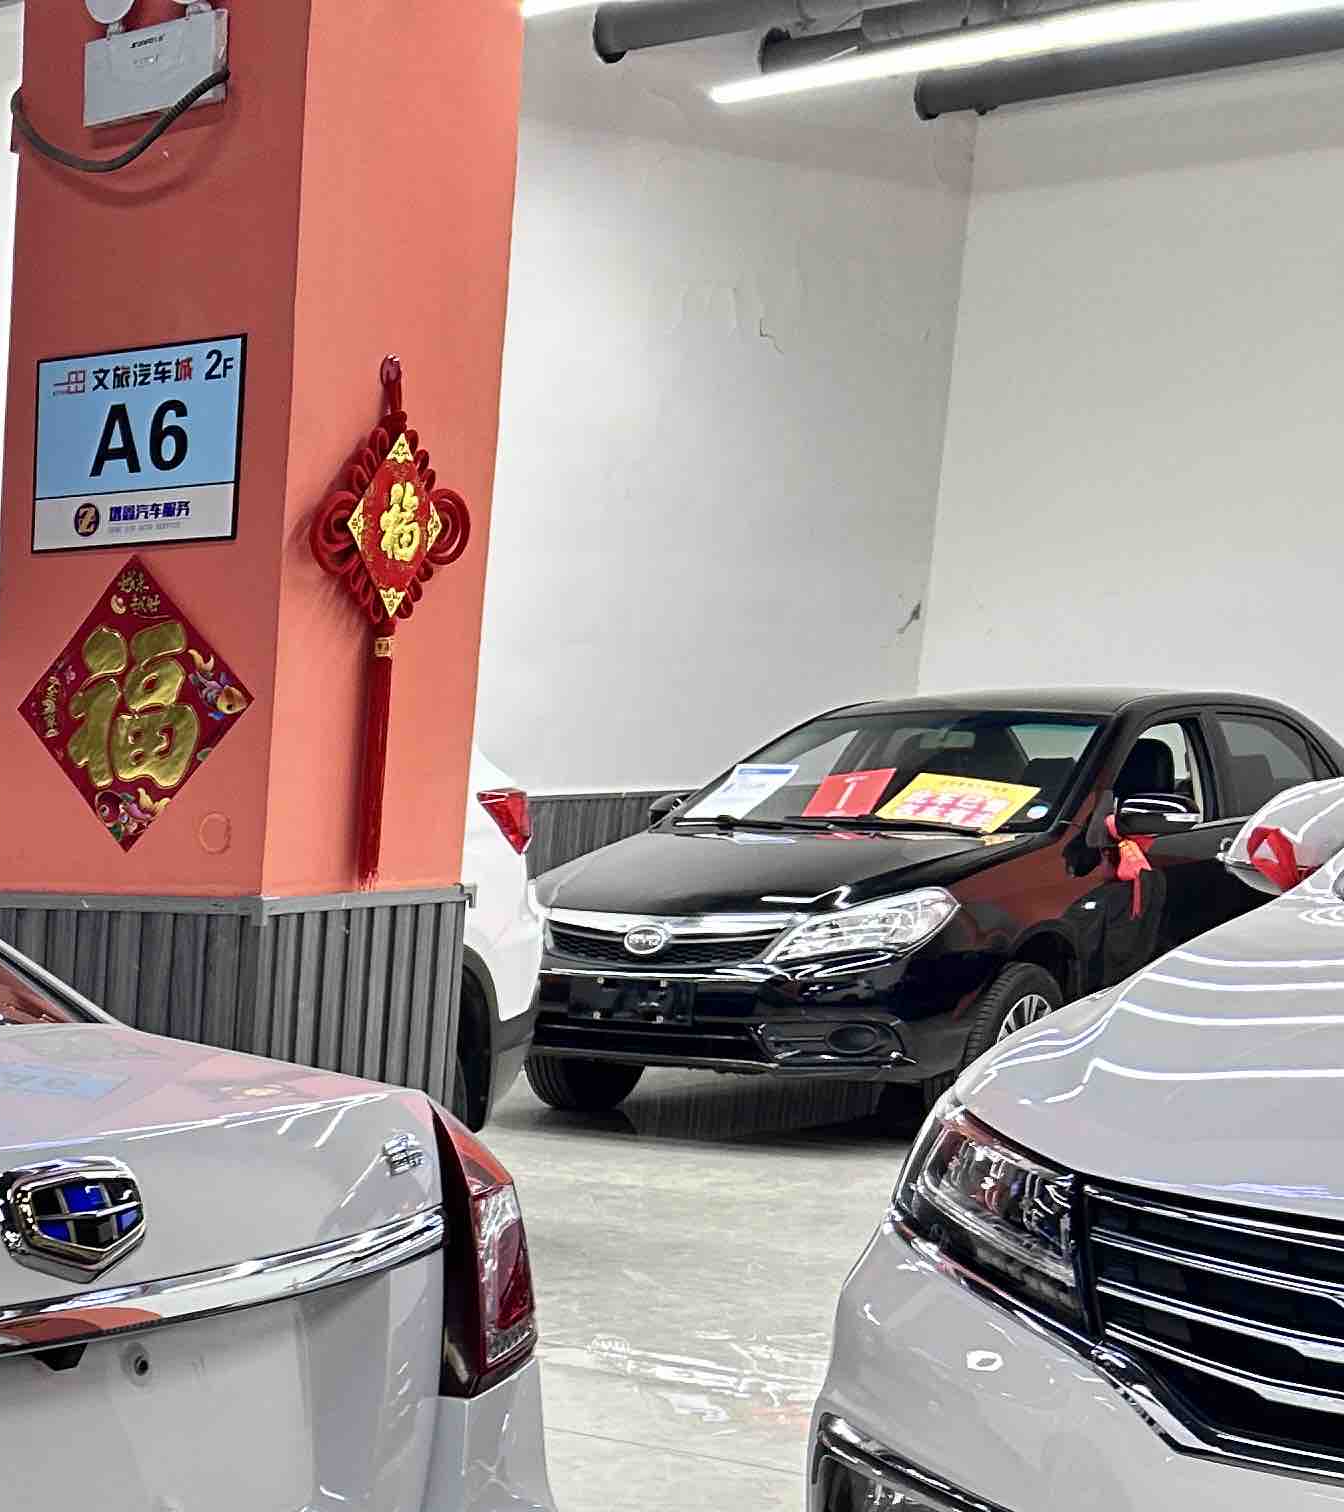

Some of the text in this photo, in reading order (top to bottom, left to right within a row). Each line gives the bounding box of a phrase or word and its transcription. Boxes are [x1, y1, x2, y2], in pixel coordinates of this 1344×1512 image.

[92, 348, 235, 392] 文旅汽车城 2F
[89, 399, 189, 478] A6
[379, 480, 420, 562] 福
[66, 621, 200, 787] 福
